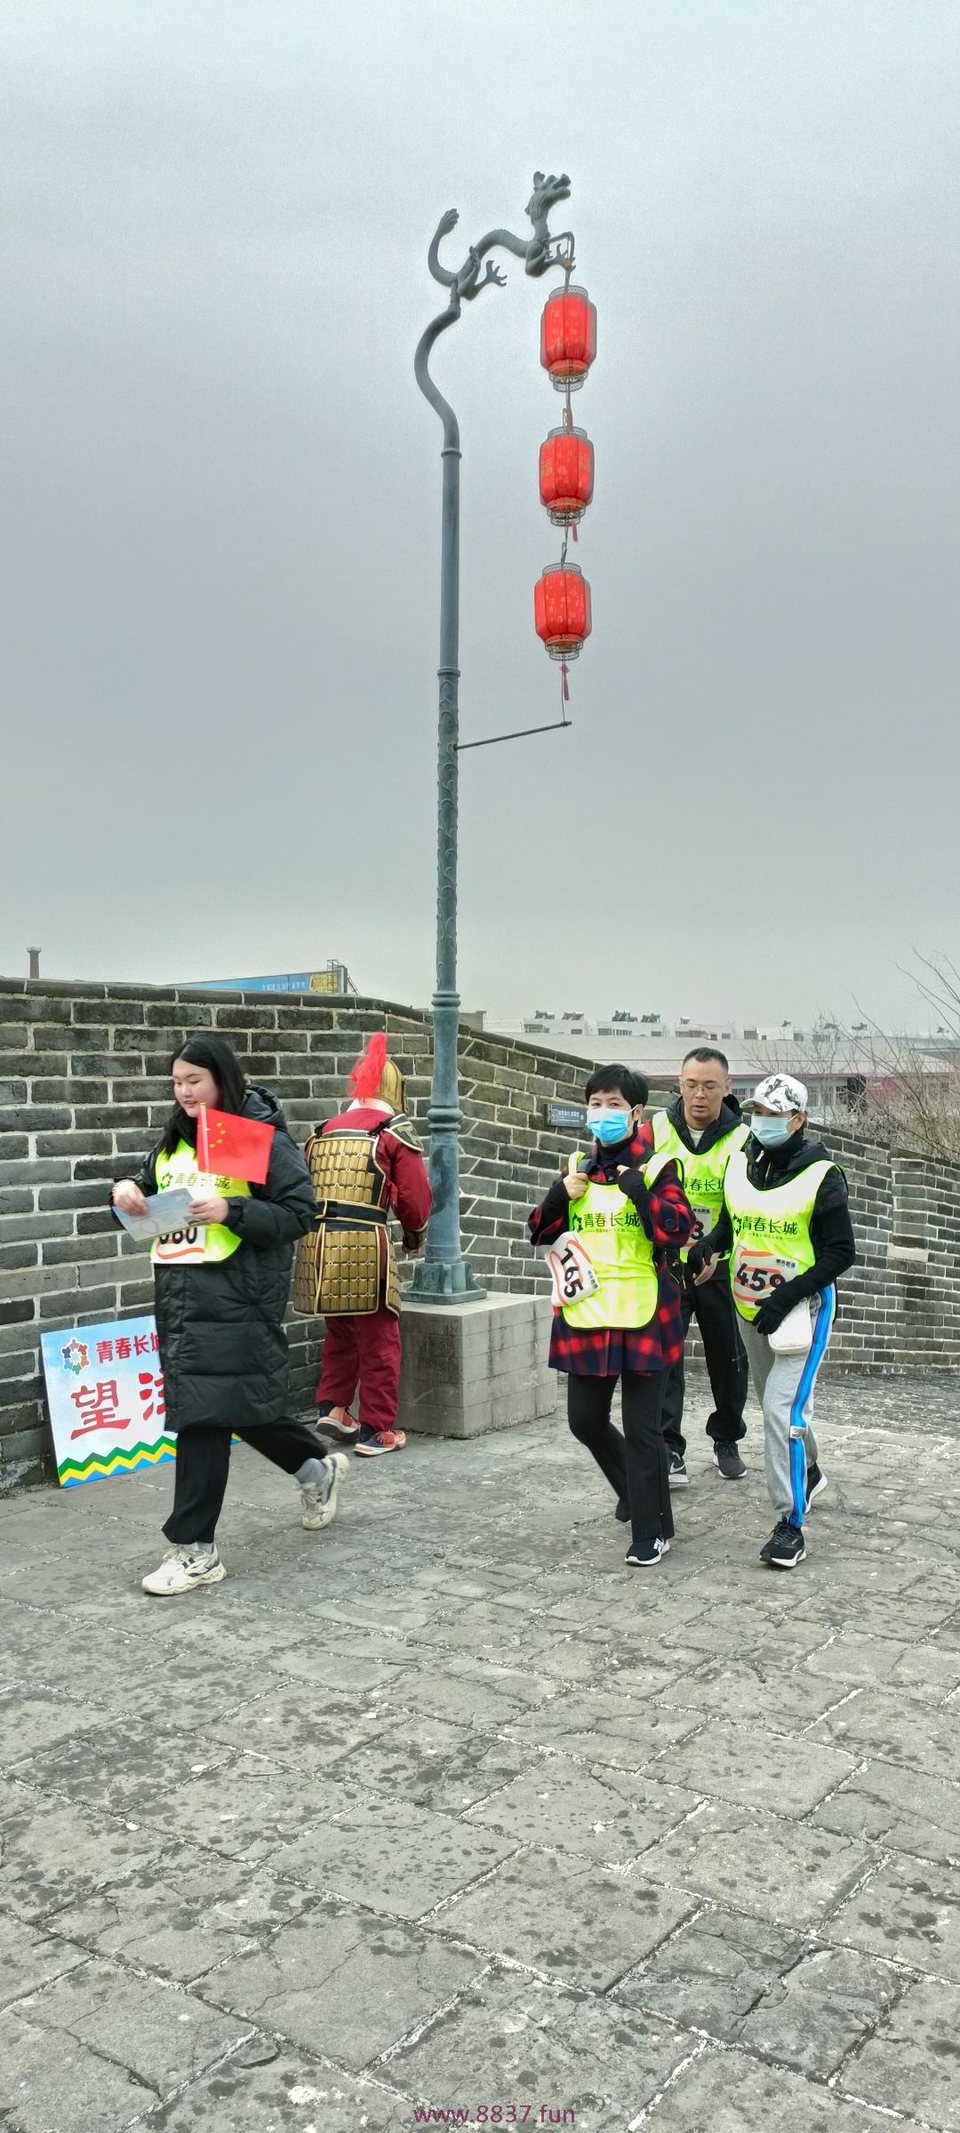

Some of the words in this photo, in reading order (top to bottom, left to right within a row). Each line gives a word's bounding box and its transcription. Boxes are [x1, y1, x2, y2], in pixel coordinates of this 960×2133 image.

[584, 1211, 641, 1228] 青春长城
[742, 1215, 798, 1235] 青春长城
[560, 1247, 584, 1298] 165
